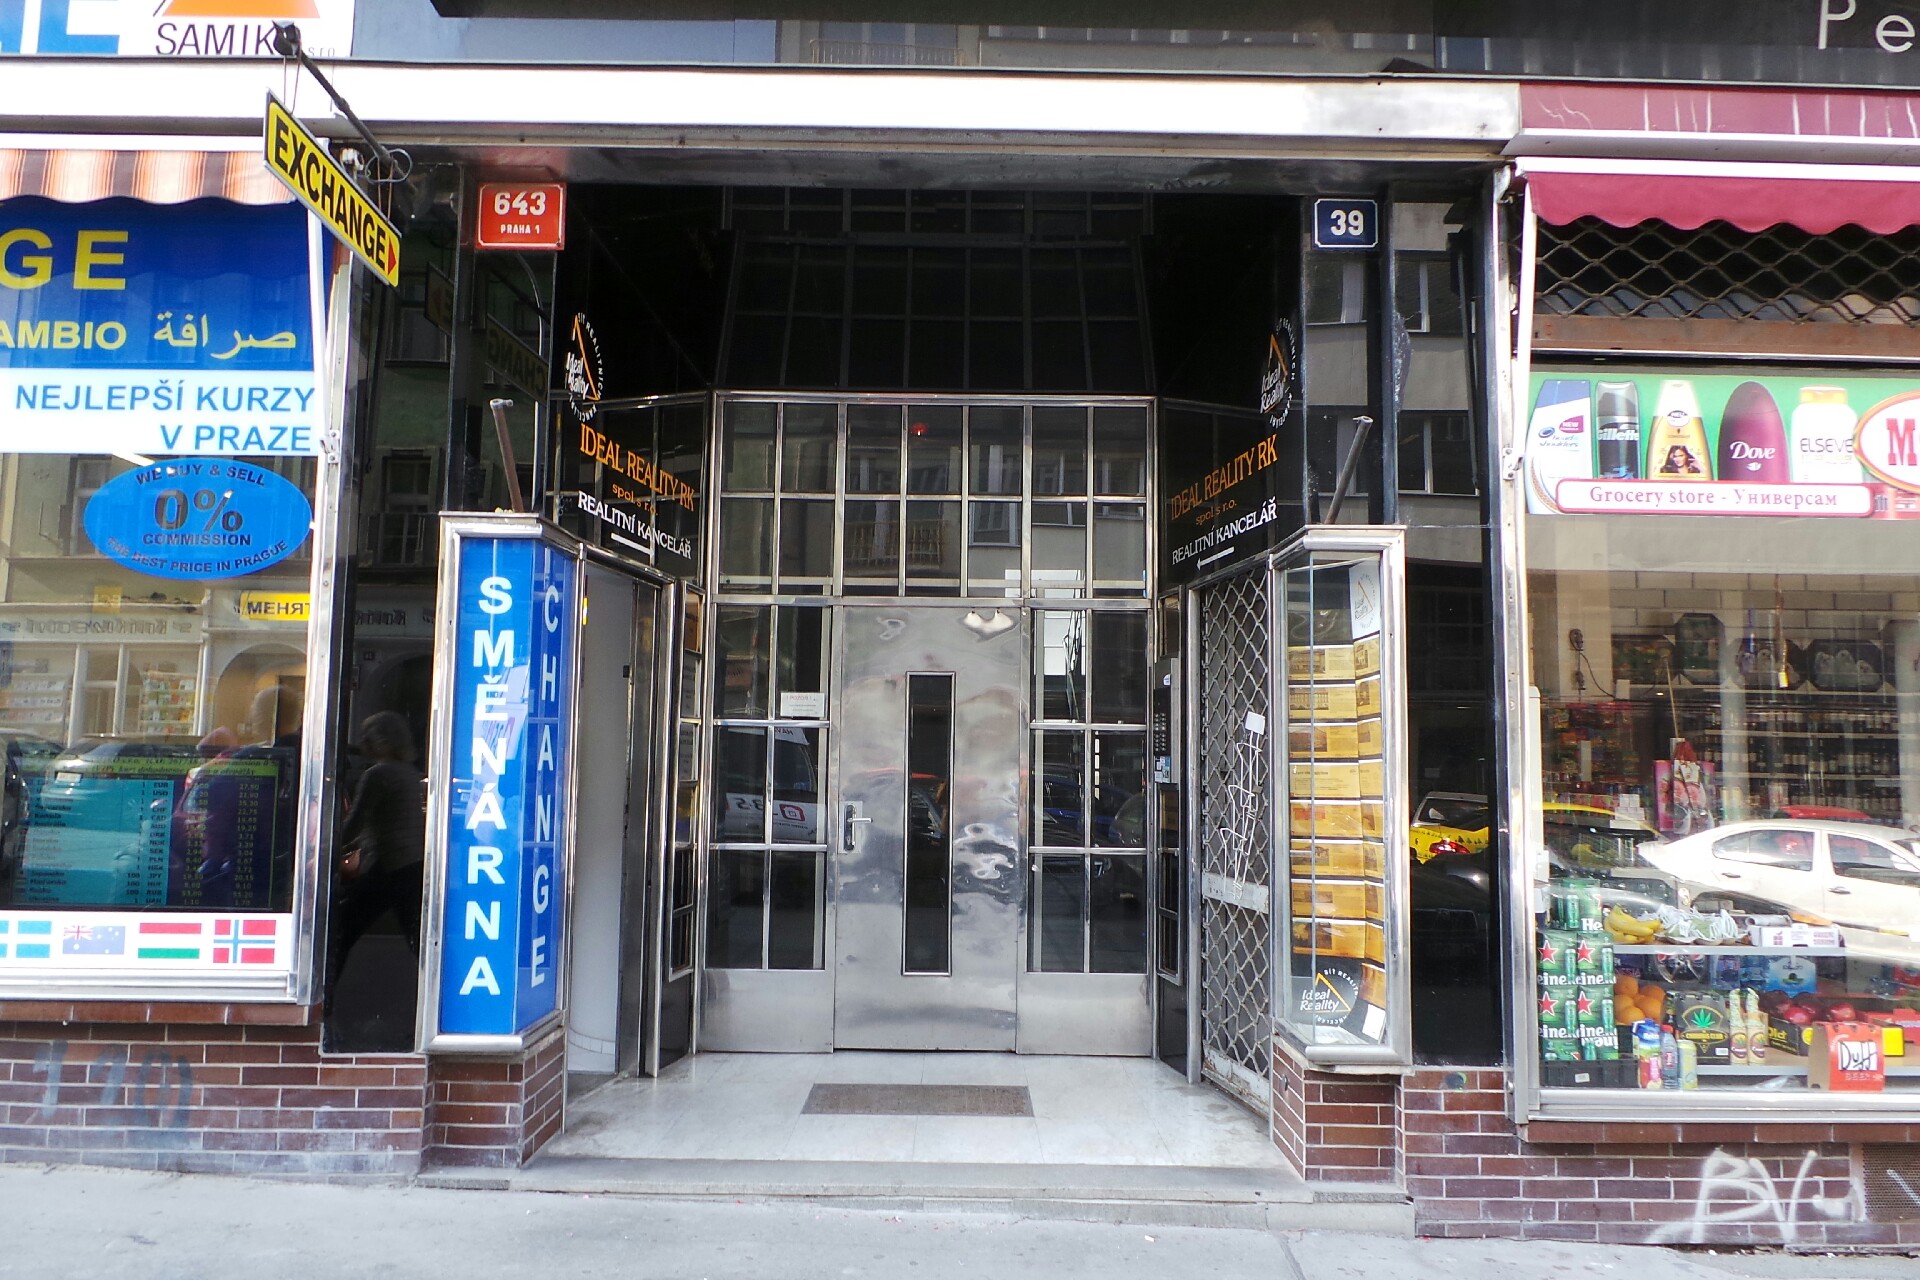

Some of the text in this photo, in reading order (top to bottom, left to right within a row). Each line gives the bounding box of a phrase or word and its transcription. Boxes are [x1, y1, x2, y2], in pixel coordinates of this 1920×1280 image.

[155, 22, 276, 55] SAMIK
[275, 114, 388, 271] EXCHANGE
[494, 191, 546, 216] 643
[500, 224, 541, 235] PRAHA 1
[1330, 209, 1364, 236] 39
[0, 228, 129, 290] GE
[1261, 361, 1281, 394] Ideal
[16, 379, 315, 412] NEJLEPŠÍ KURZY
[160, 425, 311, 452] V PRAZE
[1729, 441, 1776, 459] Dove
[1800, 437, 1854, 454] ELSEVE
[136, 468, 163, 486] WE
[210, 464, 220, 476] &
[226, 466, 265, 486] SELL
[580, 423, 695, 512] IDEAL REALITY RK
[1171, 433, 1278, 520] IDEAL REALITY RK
[154, 488, 243, 532] 0%
[1590, 487, 1664, 509] Grocery
[1669, 490, 1714, 504] store
[1733, 489, 1838, 510] Универсам
[142, 533, 251, 546] COMMISSION
[578, 490, 692, 560] REALITNÍ KANCELÁŘ
[1172, 495, 1278, 565] REALITNÍ KANCELÁŘ
[132, 551, 167, 569] BEST
[170, 561, 212, 573] PRICE
[217, 559, 230, 571] IN
[235, 540, 288, 569] PRAGUE
[459, 576, 514, 996] SMĚNÁRNA
[531, 584, 559, 989] CHANGE
[1300, 1000, 1340, 1013] Reality
[1302, 988, 1331, 1000] Ideal
[1839, 1039, 1878, 1071] Duff
